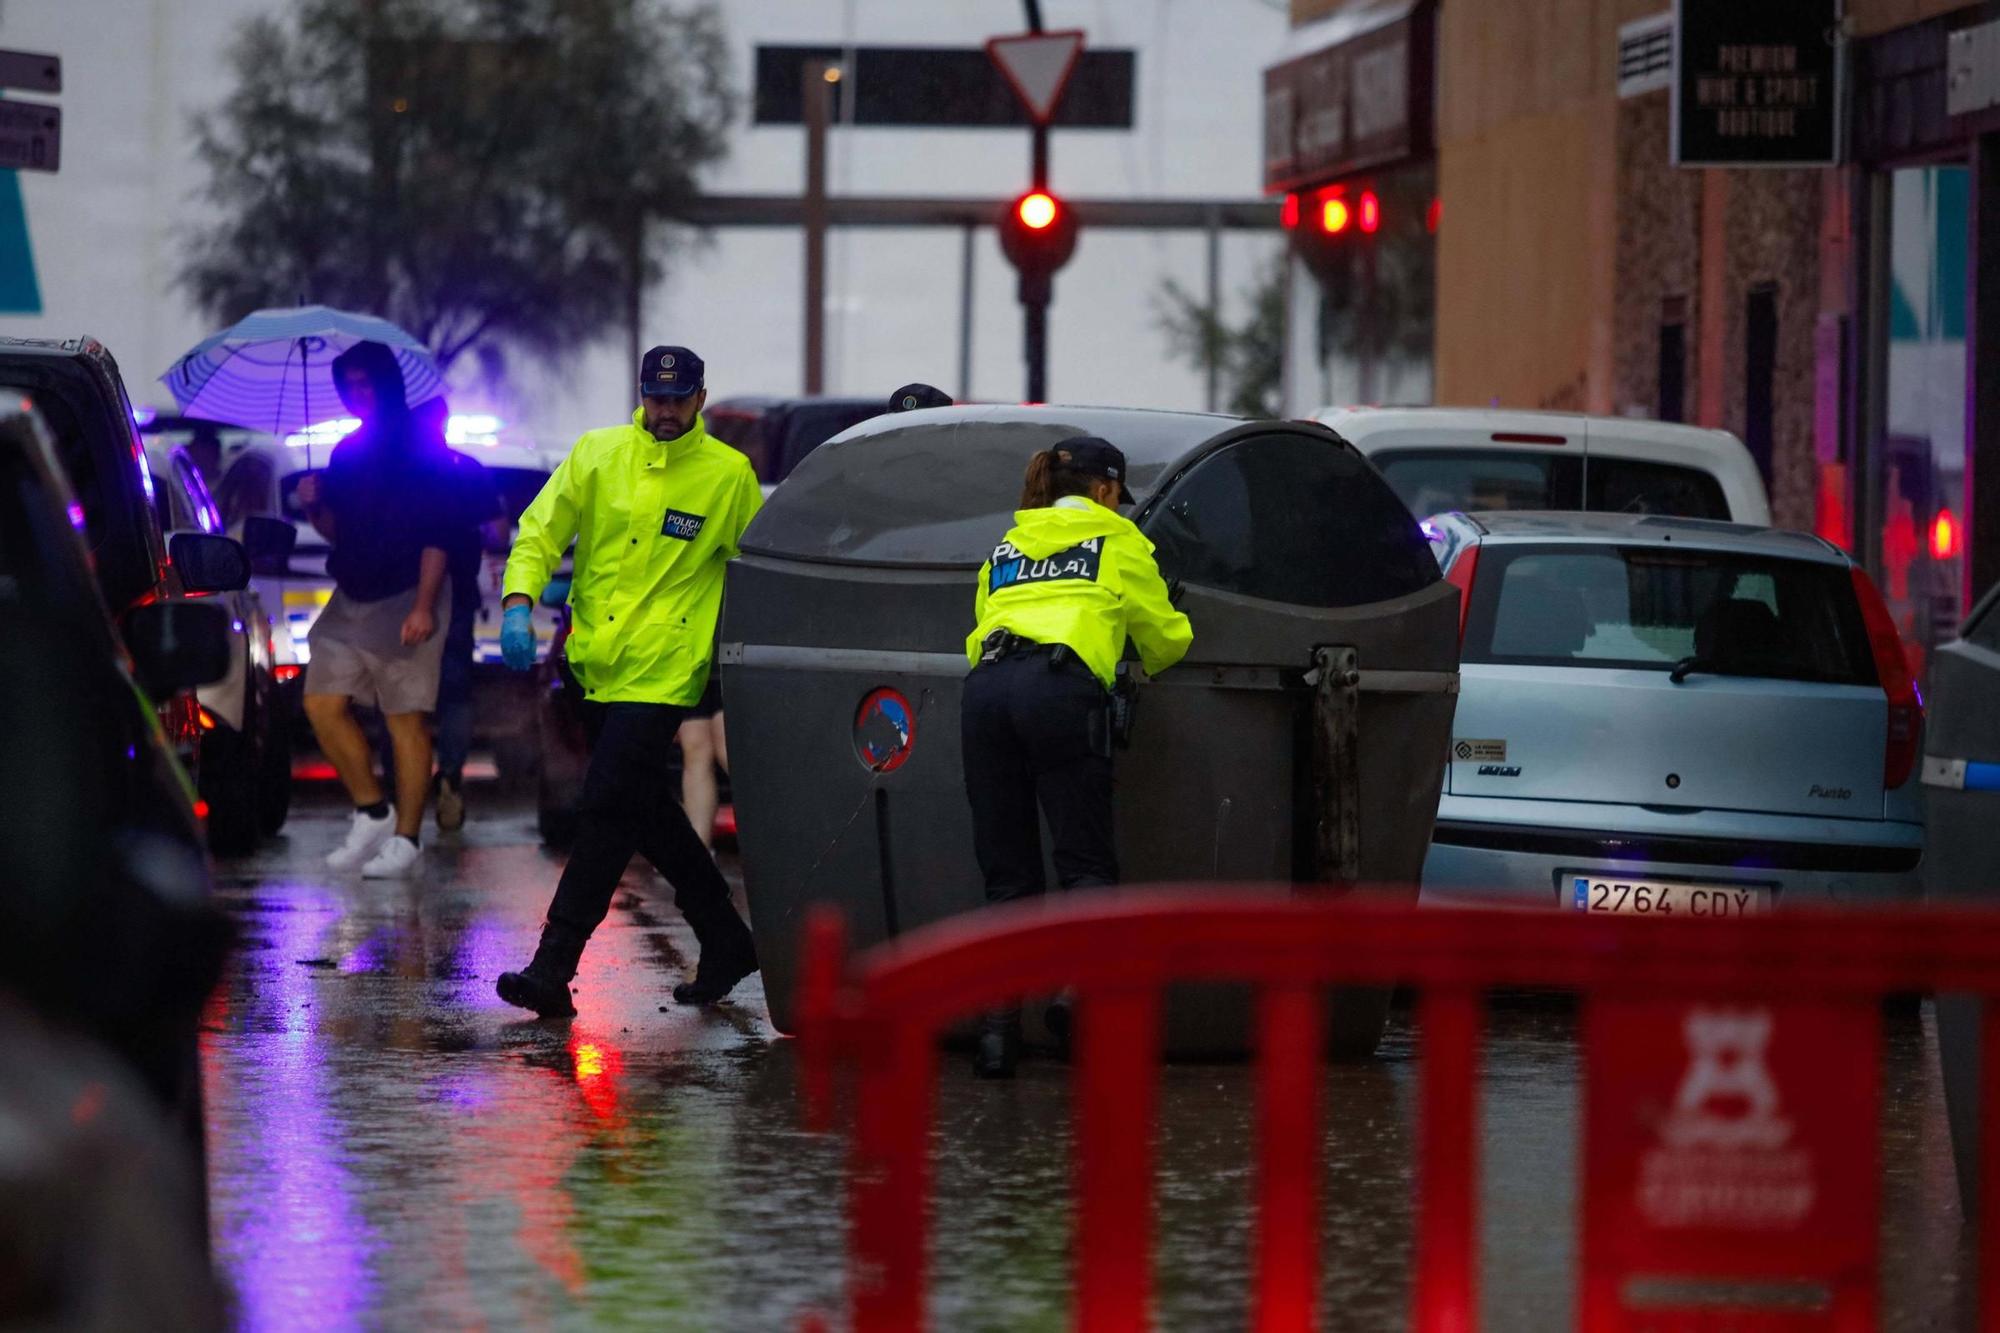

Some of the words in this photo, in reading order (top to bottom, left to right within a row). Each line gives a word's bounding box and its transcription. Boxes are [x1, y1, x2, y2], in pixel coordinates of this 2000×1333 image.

[1808, 784, 1852, 800] Punto
[1591, 884, 1673, 914] 2764
[1690, 890, 1750, 918] CDY
